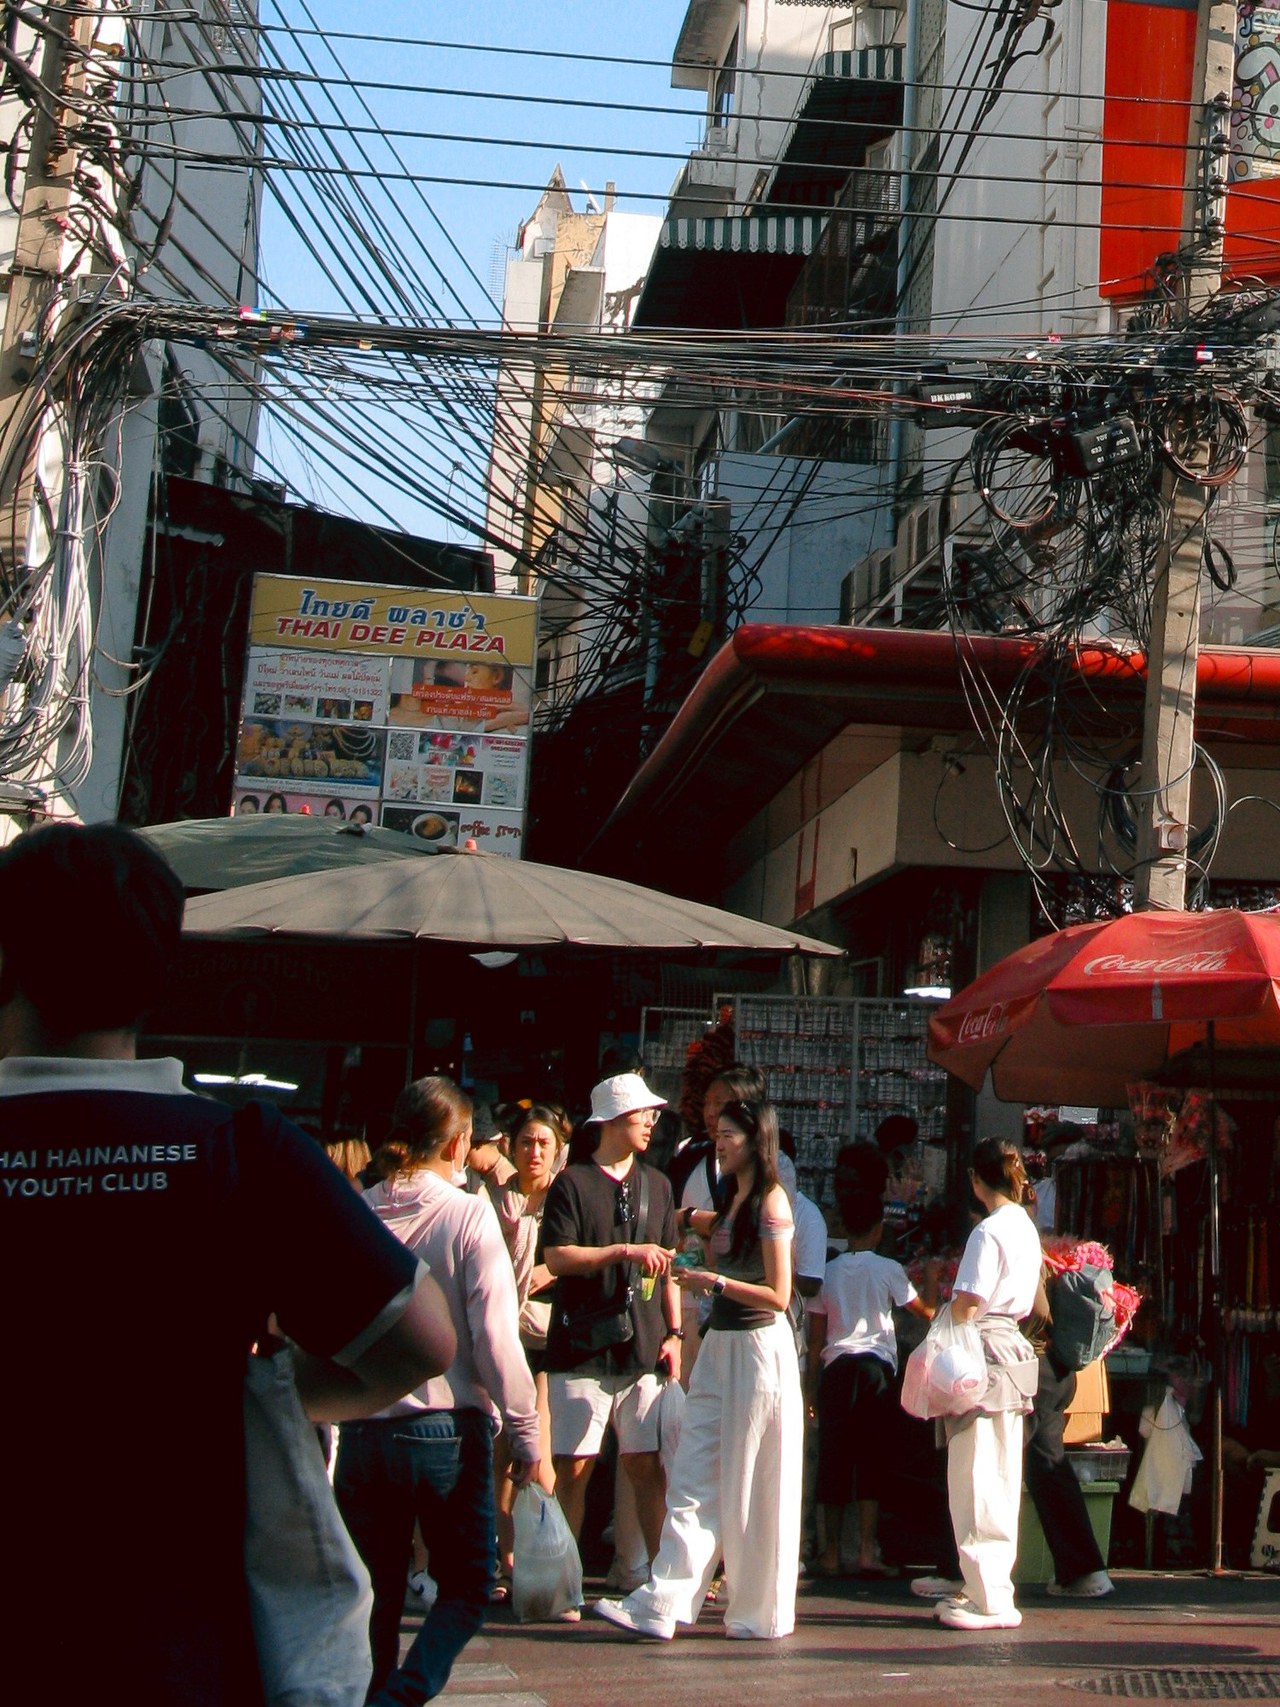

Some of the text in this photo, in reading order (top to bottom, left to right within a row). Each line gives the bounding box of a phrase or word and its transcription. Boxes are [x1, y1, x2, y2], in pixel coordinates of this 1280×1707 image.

[299, 590, 487, 631] ไทยดี พลาซ่า
[276, 617, 506, 654] THAI DEE PLAZA
[46, 1144, 197, 1169] HAINANESE
[3, 1171, 168, 1198] YOUTH CLUB
